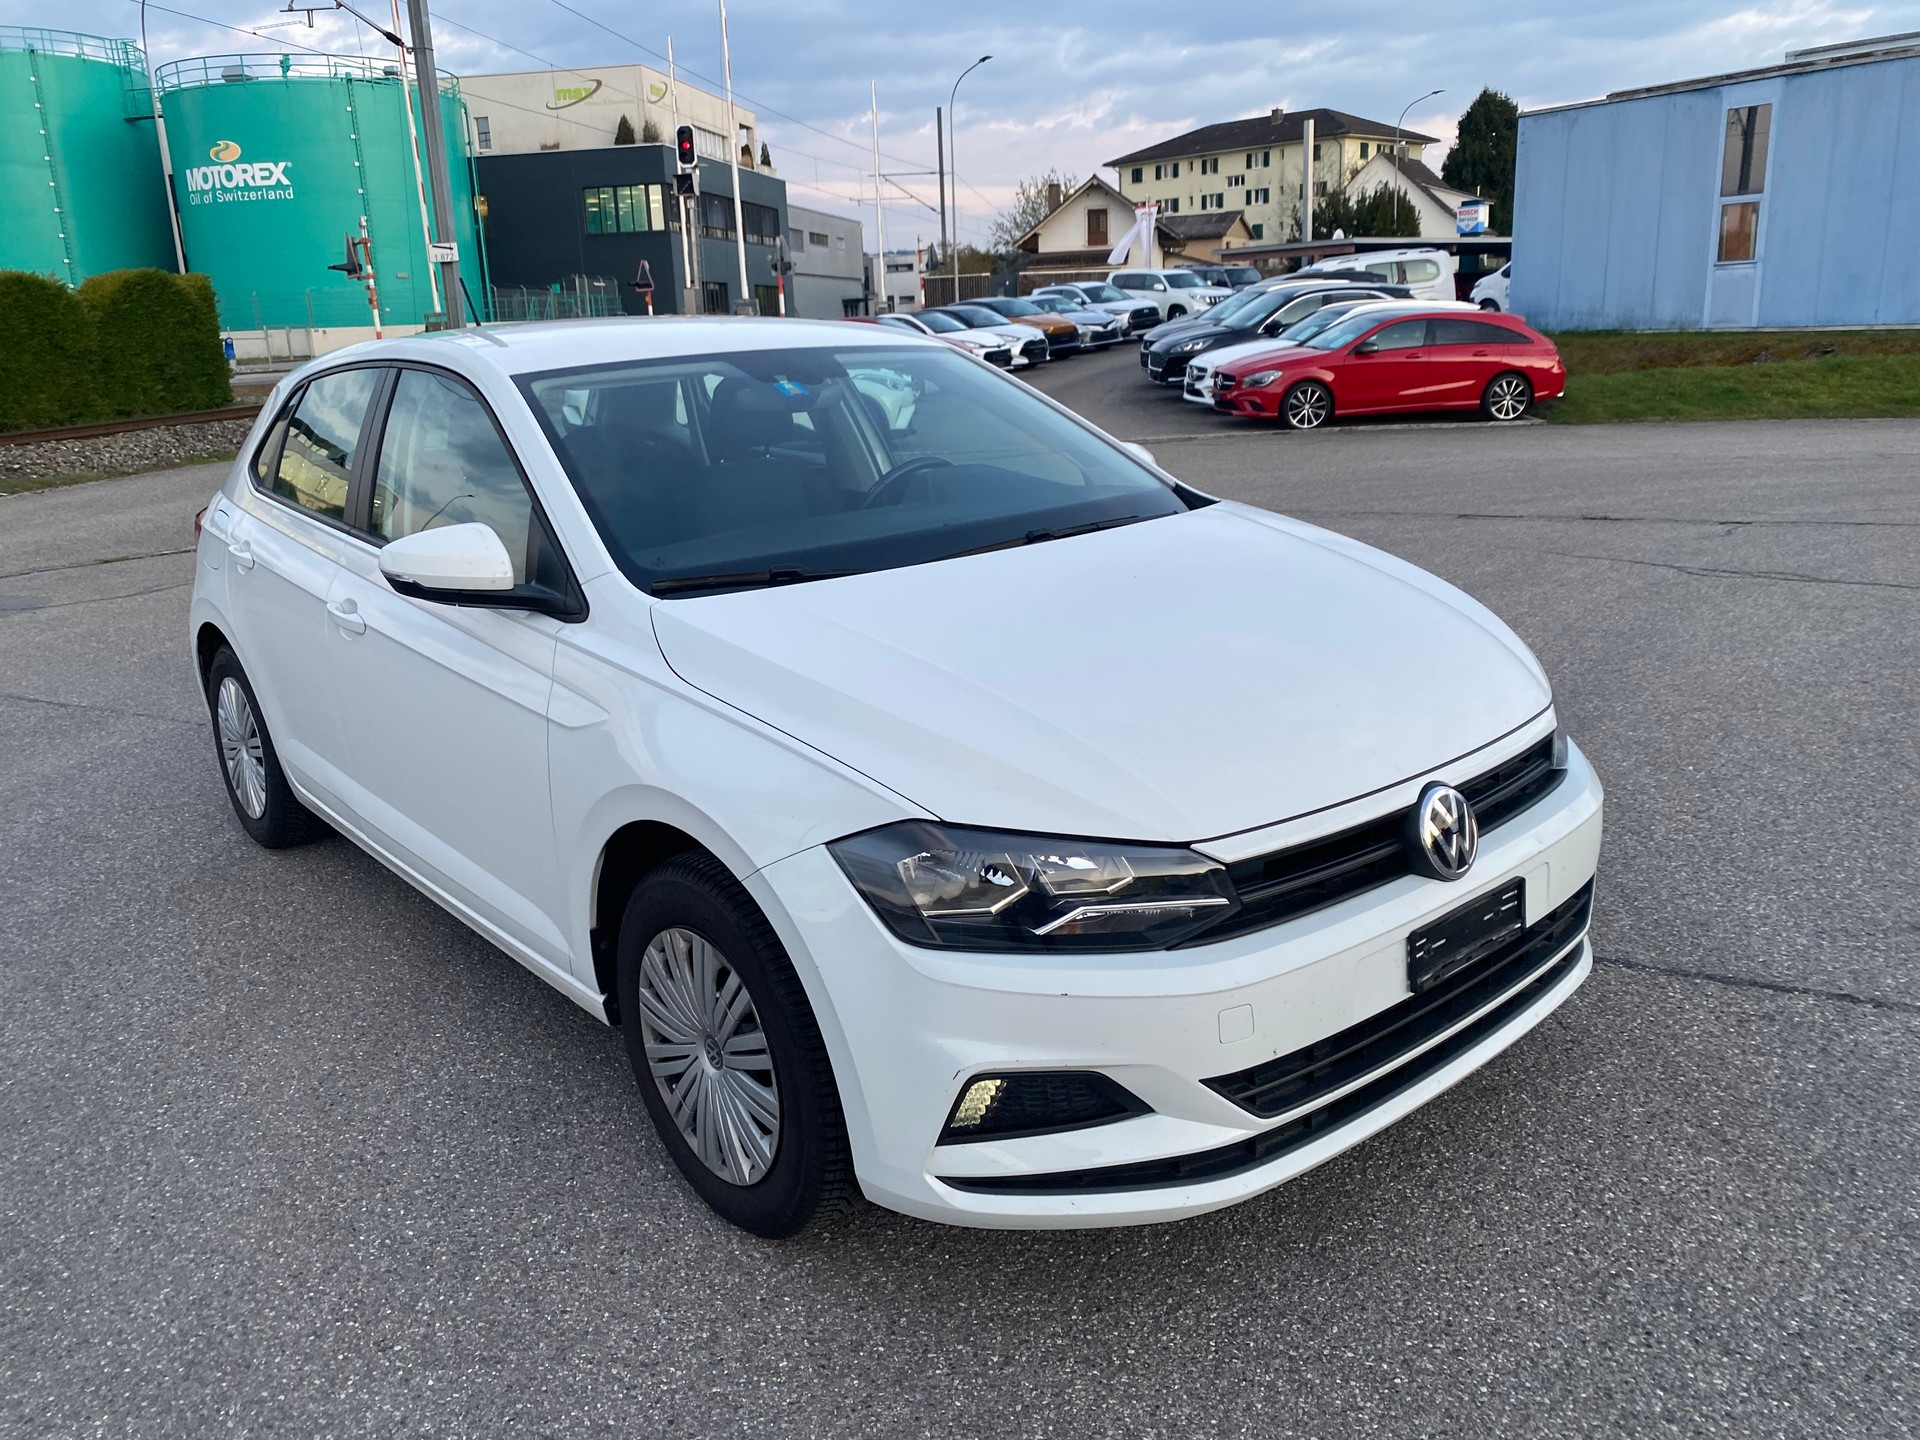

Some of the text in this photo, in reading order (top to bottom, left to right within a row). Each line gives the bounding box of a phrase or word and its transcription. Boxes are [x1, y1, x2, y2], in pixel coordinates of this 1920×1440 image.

[185, 162, 291, 192] MOTOREX
[189, 187, 294, 206] Oil of Switzerland
[1458, 208, 1479, 217] BOSCH
